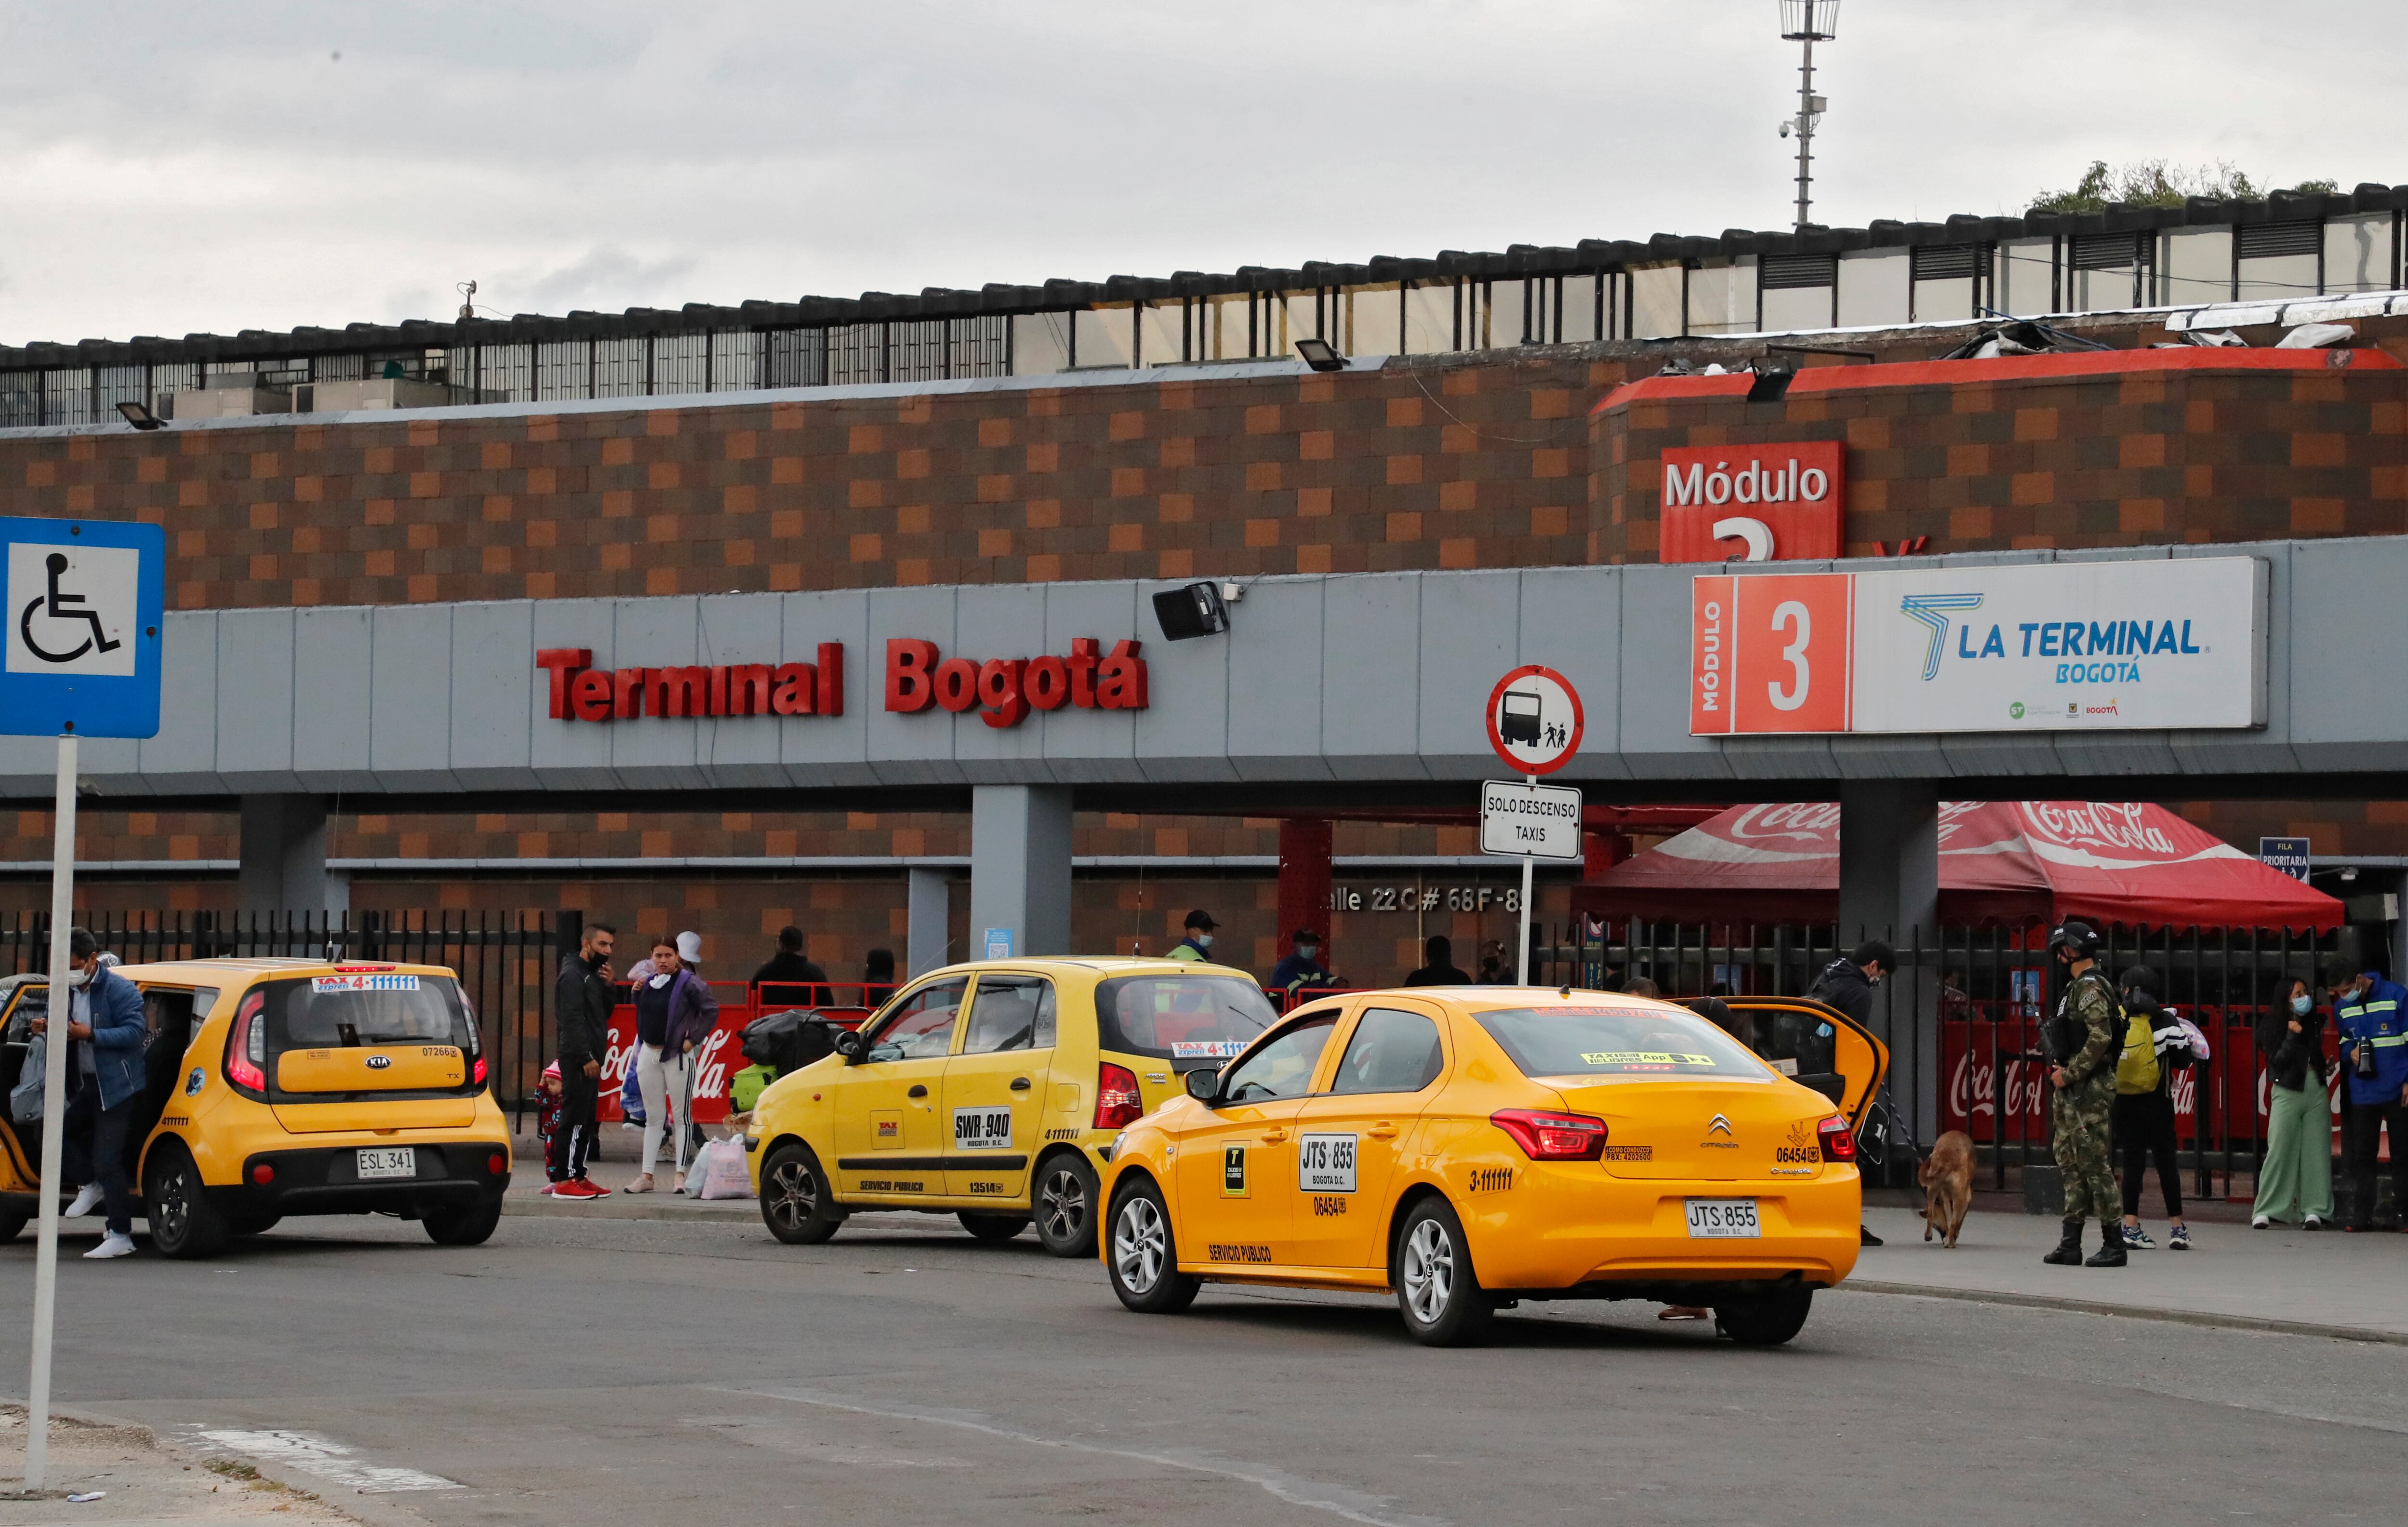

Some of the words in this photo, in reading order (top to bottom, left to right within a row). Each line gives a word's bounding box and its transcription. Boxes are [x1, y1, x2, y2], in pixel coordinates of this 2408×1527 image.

[1666, 458, 1828, 506] Módulo
[1958, 624, 2005, 658] LA
[2019, 620, 2200, 657] TERMINAL
[1699, 602, 1720, 711] MÓDULO
[1768, 600, 1810, 711] 3
[2055, 655, 2141, 683] BOGOTÁ
[537, 642, 843, 722] Terminal
[885, 637, 1150, 728] Bogotá
[1488, 797, 1517, 812] SOLO
[1519, 800, 1575, 817] DESCENSO
[1516, 826, 1545, 842] TAXIS
[2263, 856, 2307, 866] PRIORITARIA
[423, 1047, 450, 1056] 07266
[370, 1058, 388, 1066] KIA
[360, 1153, 385, 1169] ESL
[388, 1152, 412, 1168] 341
[1777, 1147, 1807, 1163] 06454
[860, 1180, 891, 1191] SERVICIO
[894, 1181, 923, 1192] PUBLICO
[970, 1182, 995, 1193] 13514
[1313, 1176, 1333, 1184] BOGOTA
[1335, 1176, 1345, 1185] D.C.
[1314, 1196, 1338, 1217] 06454
[1209, 1244, 1240, 1261] SERVICIO
[1240, 1246, 1271, 1262] PUBLICO
